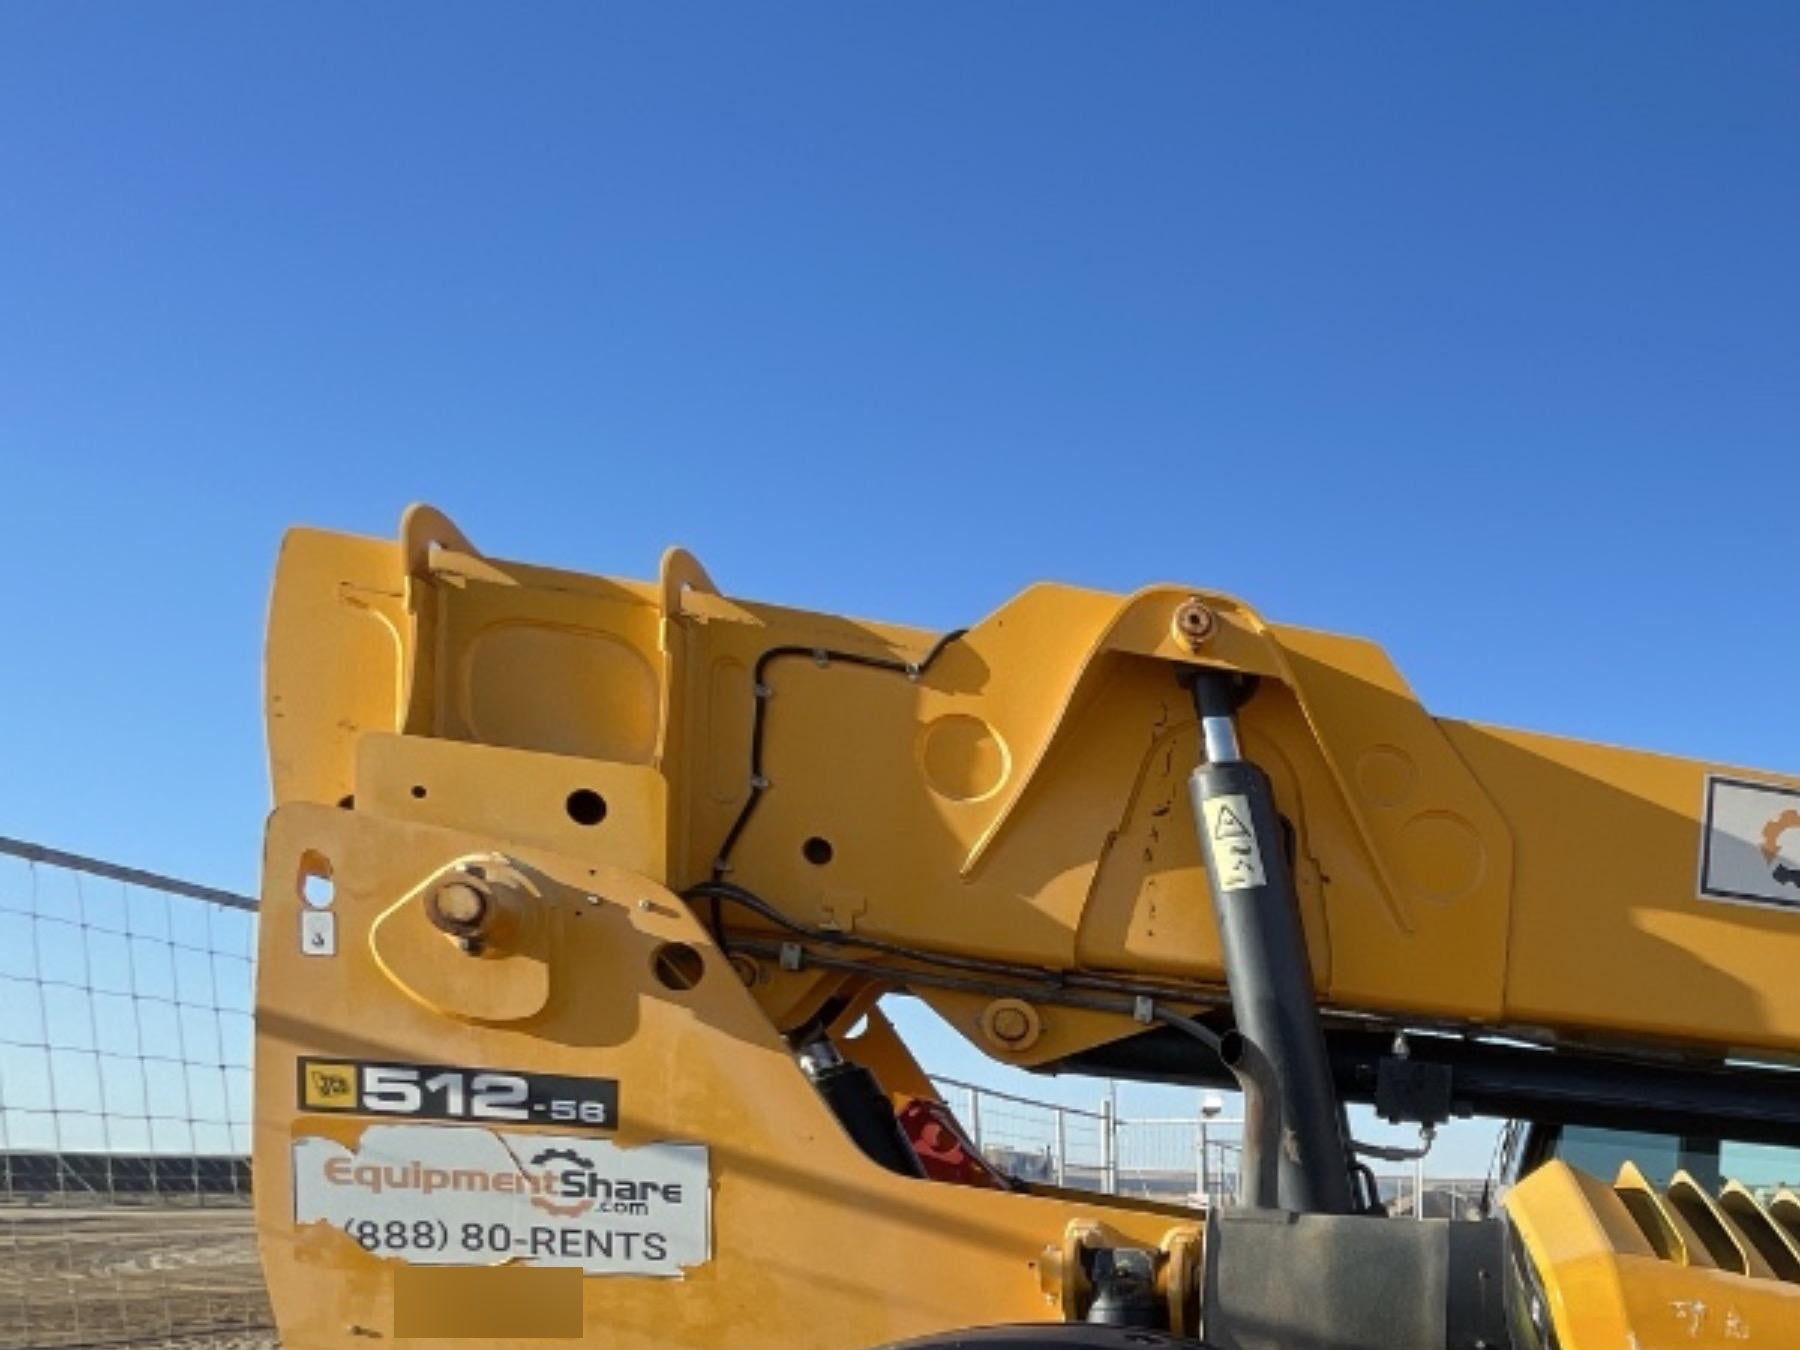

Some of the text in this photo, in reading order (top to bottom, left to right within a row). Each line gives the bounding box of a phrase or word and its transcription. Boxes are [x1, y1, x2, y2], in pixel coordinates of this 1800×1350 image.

[323, 1157, 683, 1204] EquipmentShare
[594, 1201, 649, 1216] .com
[344, 1217, 668, 1262] (888) 80-RENTS
